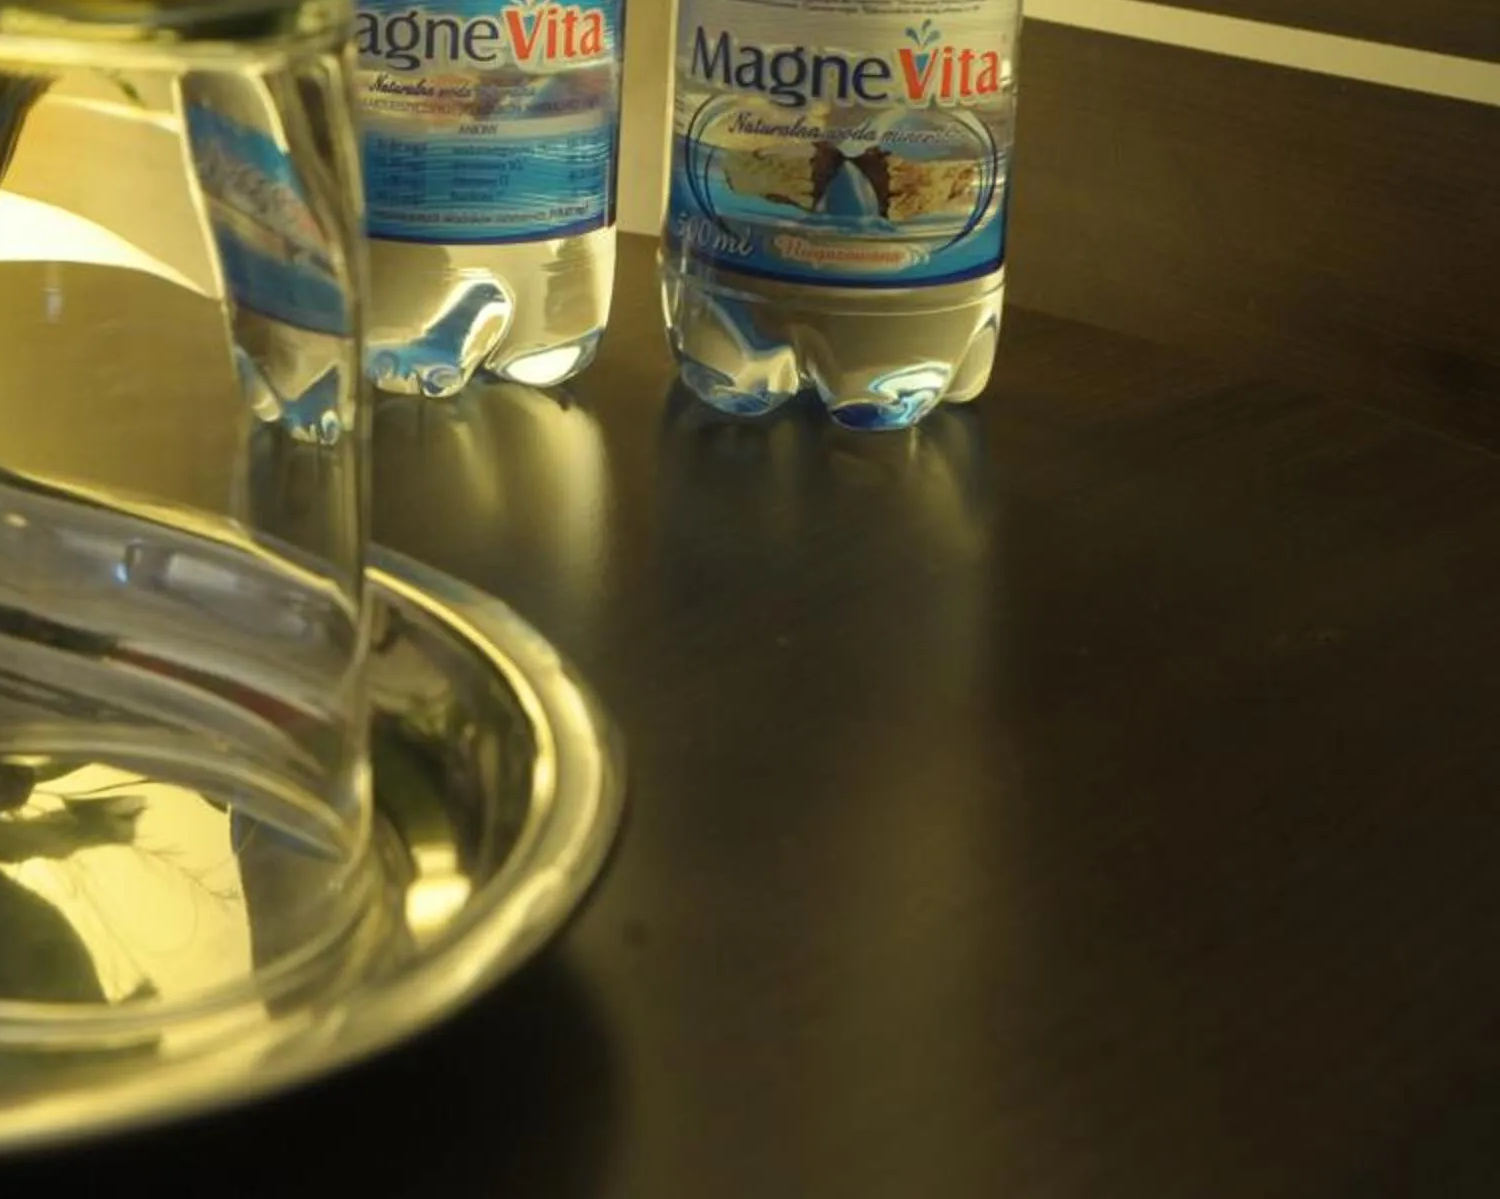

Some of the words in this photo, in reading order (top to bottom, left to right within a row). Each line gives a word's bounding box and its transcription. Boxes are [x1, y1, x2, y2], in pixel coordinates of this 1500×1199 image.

[355, 6, 604, 69] agneVita
[690, 26, 1001, 106] MagneVita
[726, 111, 822, 142] Naturalna
